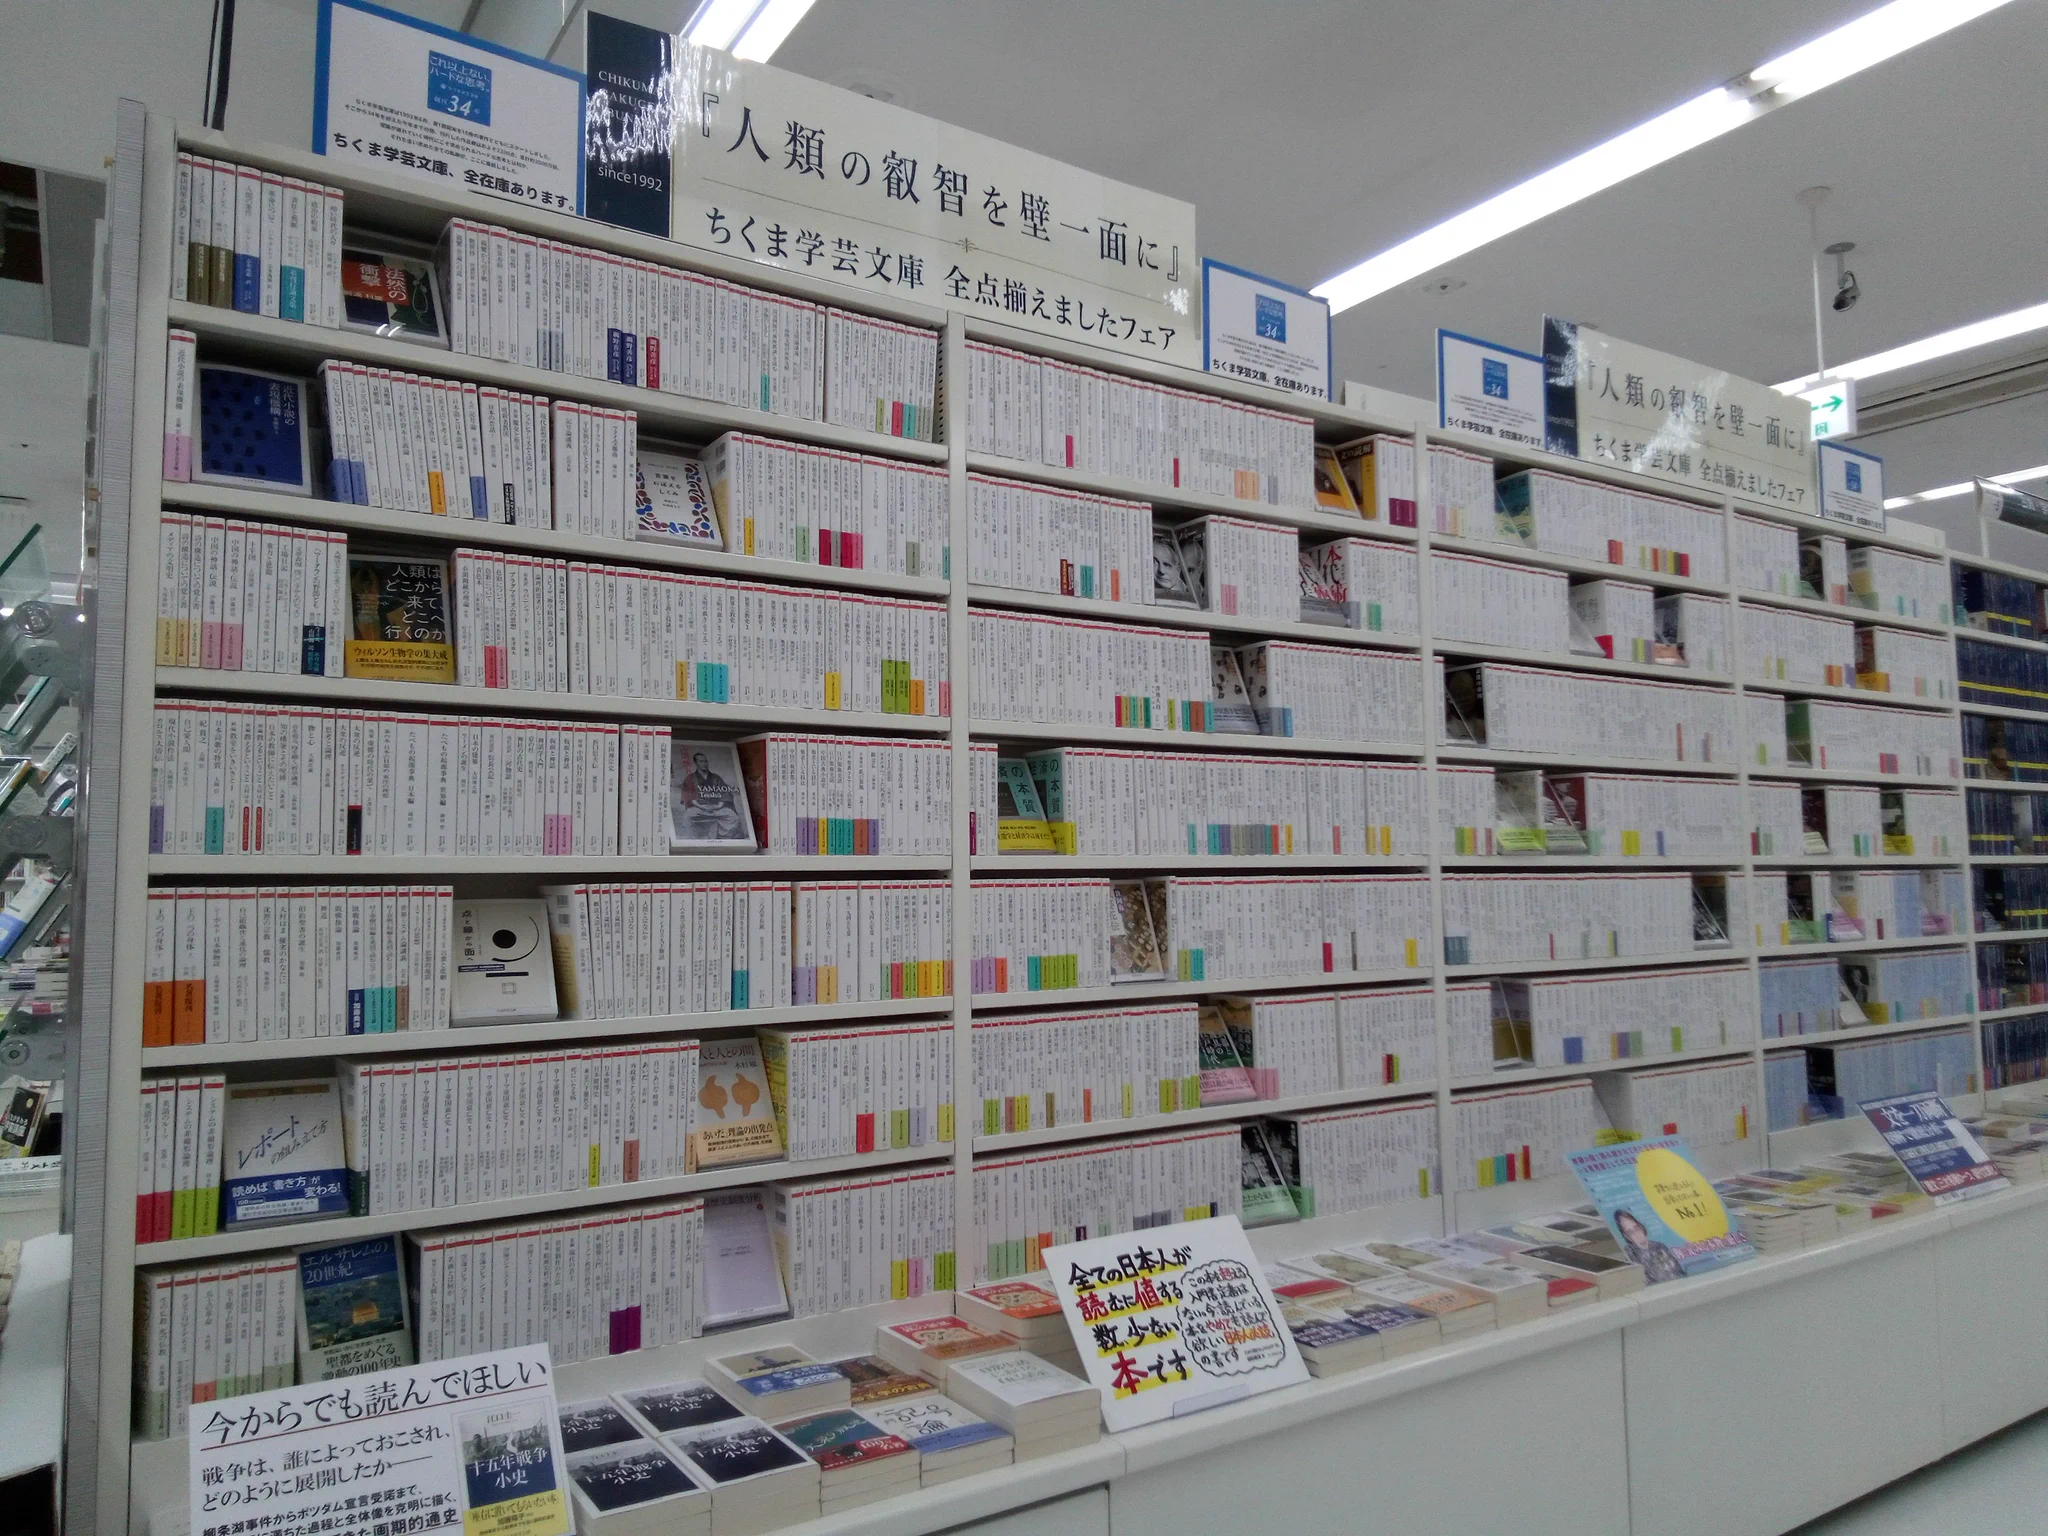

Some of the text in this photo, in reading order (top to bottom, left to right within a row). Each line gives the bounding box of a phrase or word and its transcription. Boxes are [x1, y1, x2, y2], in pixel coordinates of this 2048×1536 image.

[598, 166, 663, 192] since1992
[702, 92, 1179, 283] 『人類の叡智を壁一面に』
[705, 207, 1176, 351] ちくま学芸文庫 全点揃えましたフェア
[392, 564, 441, 579] 人類は
[386, 579, 442, 594] どこから
[402, 611, 444, 623] どこへ
[385, 625, 446, 640] 行くのか
[354, 647, 448, 660] ウィルソン生物学の集大成
[998, 766, 1024, 778] 済の
[697, 784, 740, 793] YAMAOKA
[238, 1115, 300, 1170] レポート
[271, 1120, 328, 1165] の組み立て方
[304, 1241, 389, 1267] エルサレムの
[305, 1264, 353, 1285] 20世紀
[1068, 1245, 1192, 1293] 全ての日本人が
[1076, 1276, 1184, 1322] 読むに値する
[325, 1345, 396, 1369] 聖都をめぐる
[1110, 1348, 1188, 1395] 本です
[201, 1359, 548, 1445] 今からでも読んでほしい
[469, 1447, 548, 1477] 十五年戦争
[495, 1468, 529, 1489] 小史
